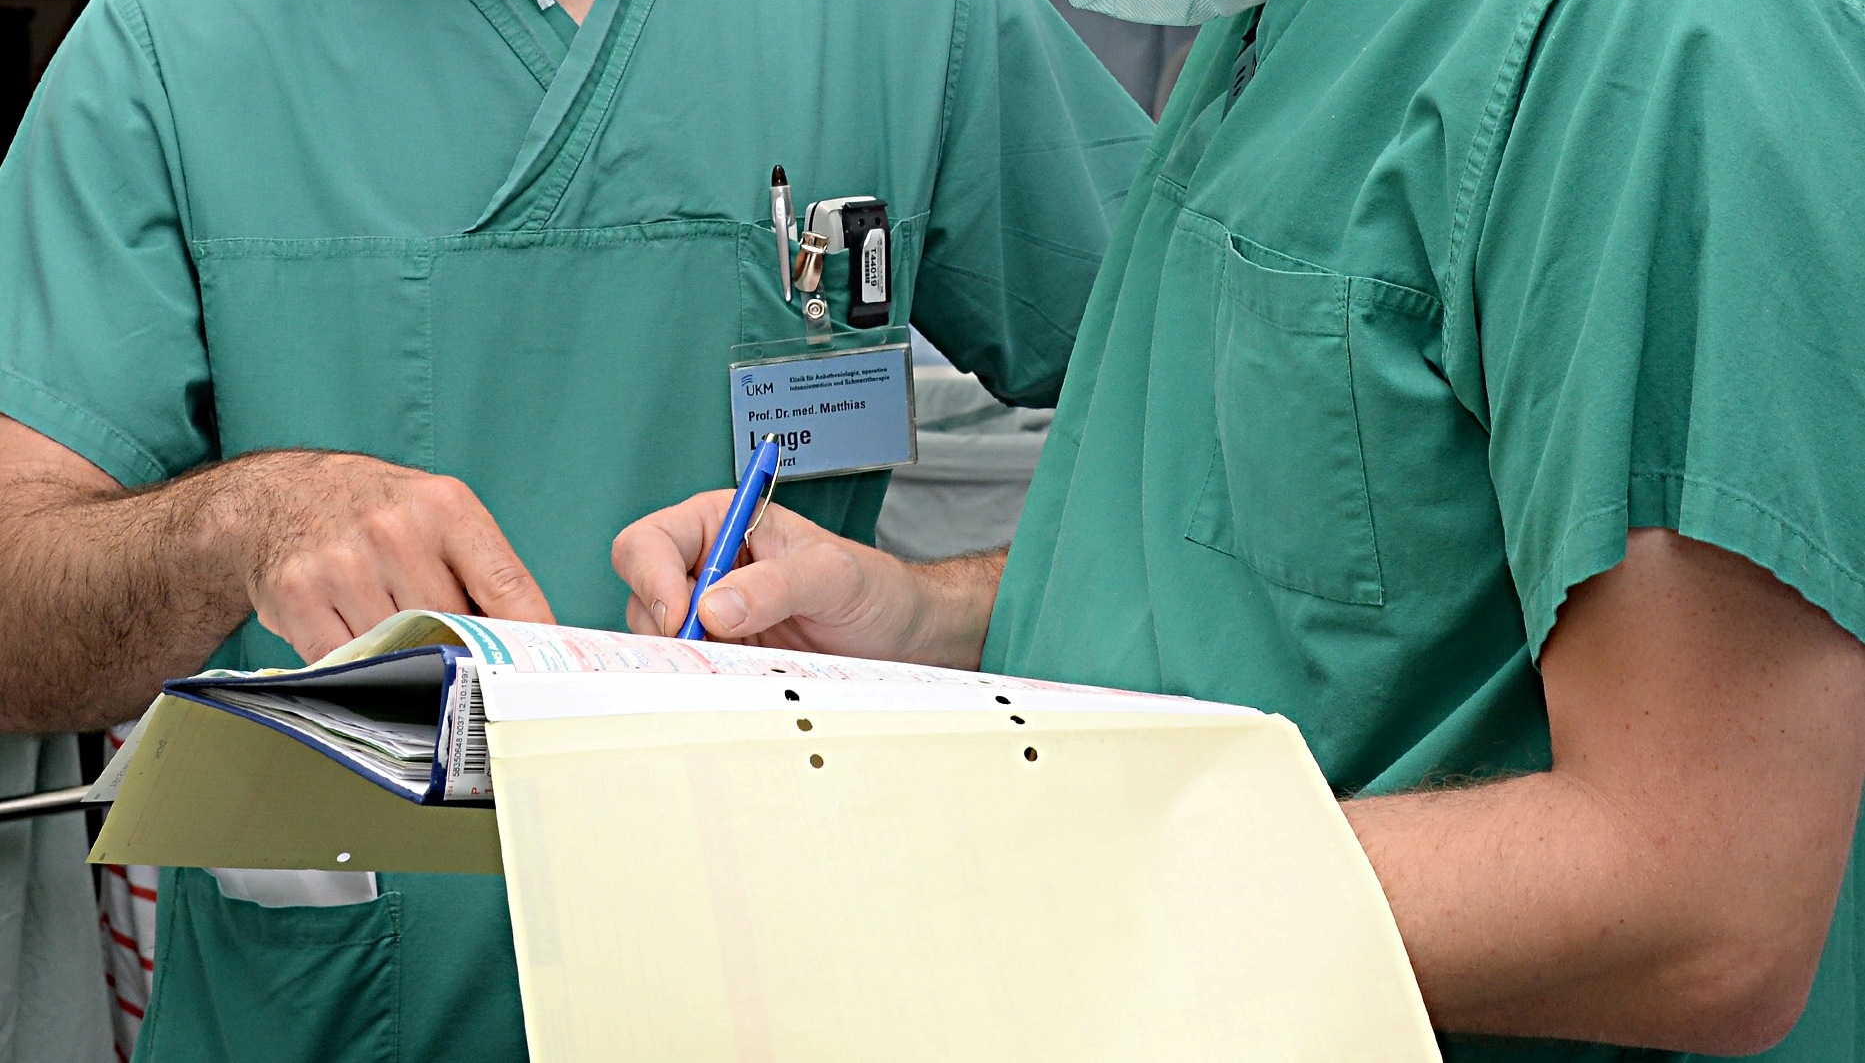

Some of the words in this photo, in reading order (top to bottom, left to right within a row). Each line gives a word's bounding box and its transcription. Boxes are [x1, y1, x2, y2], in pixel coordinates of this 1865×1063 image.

[789, 375, 806, 383] Klinik
[806, 373, 814, 381] für
[789, 381, 832, 391] Intensivmedizin
[844, 374, 890, 386] Schmerztherapie
[746, 382, 774, 397] UKM
[748, 409, 773, 422] Prof.
[775, 407, 790, 419] Dr.
[792, 404, 817, 417] med.
[819, 399, 866, 414] Matthias
[750, 429, 812, 451] Lnge
[458, 669, 469, 713] 12.10.1997
[456, 716, 465, 736] 0037
[452, 738, 463, 777] 58350648
[471, 787, 480, 795] P
